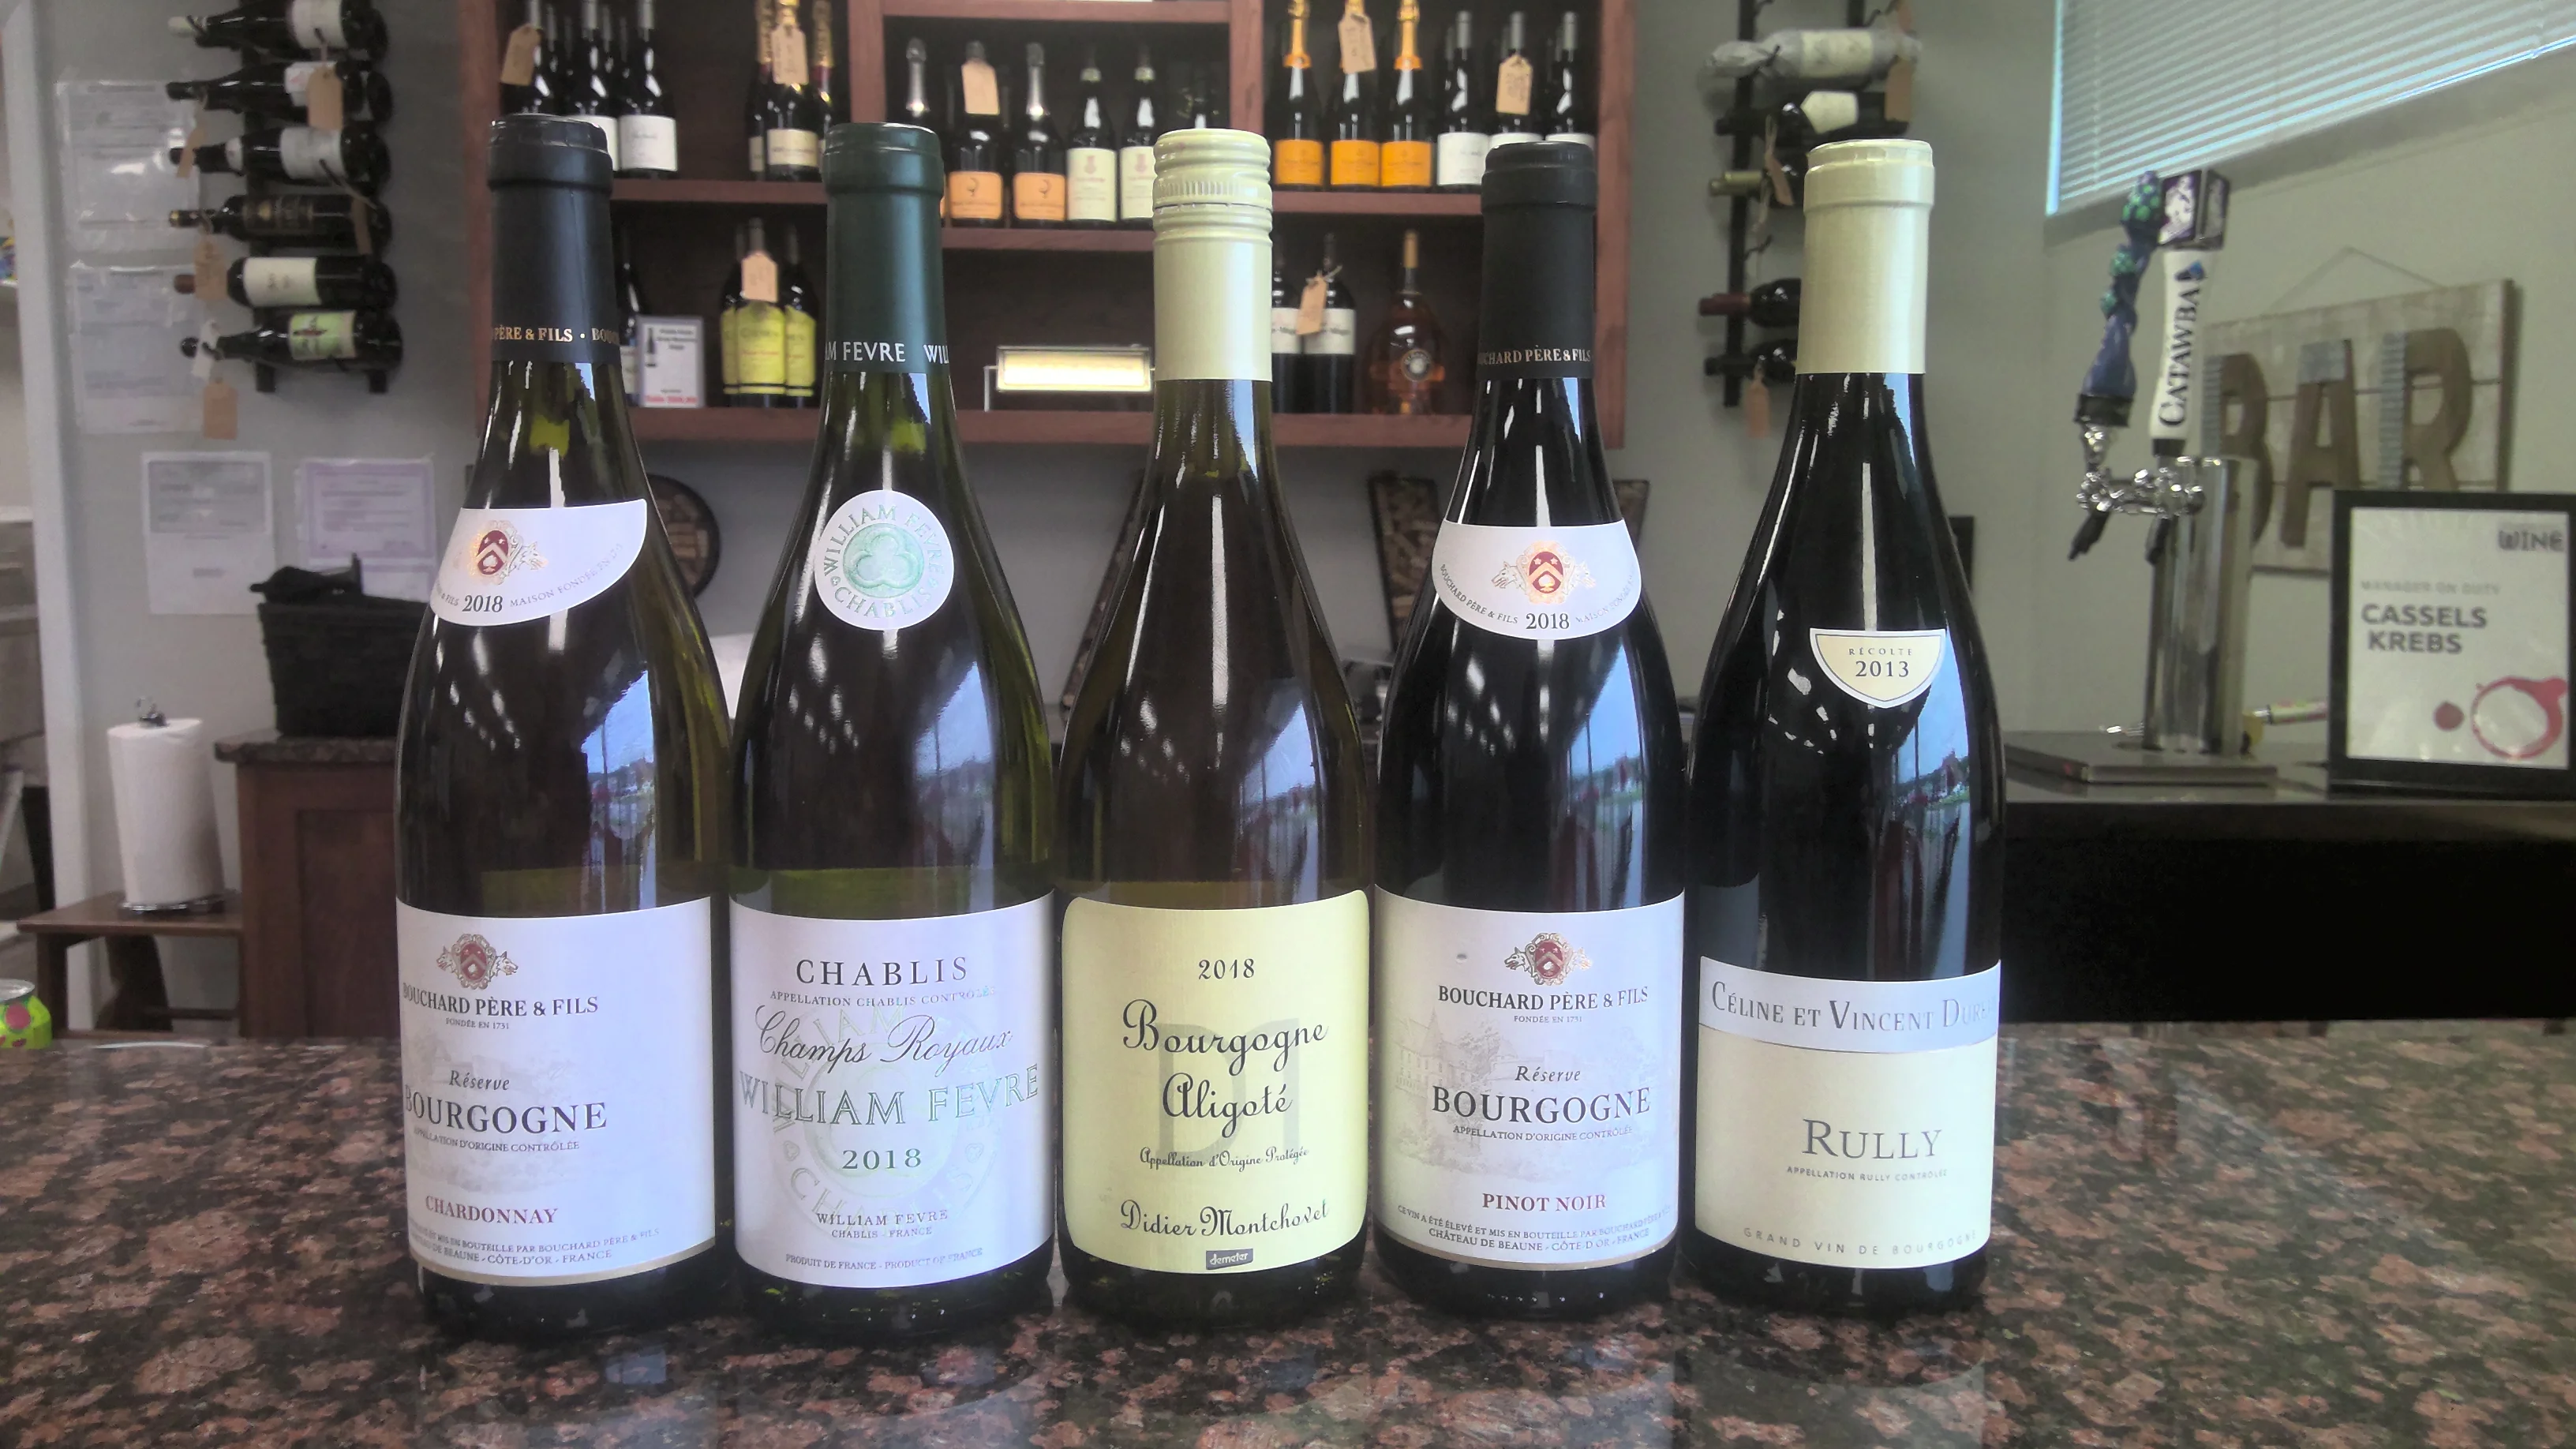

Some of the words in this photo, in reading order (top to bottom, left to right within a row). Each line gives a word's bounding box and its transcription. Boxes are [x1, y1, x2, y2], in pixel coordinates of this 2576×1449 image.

[526, 328, 534, 341] &
[538, 328, 573, 343] FILS
[843, 341, 906, 362] FEVRE
[1525, 344, 1562, 361] PÈRE
[1563, 350, 1571, 361] &
[1572, 349, 1591, 361] FILS
[2158, 286, 2202, 427] CATAWBA
[2202, 328, 2473, 548] BAR
[823, 504, 899, 576] WILLIAM
[904, 512, 945, 575] FEVRE
[2498, 530, 2563, 552] WINE
[445, 594, 460, 606] FILS
[462, 595, 504, 613] 2018
[510, 590, 556, 608] MAISON
[834, 586, 932, 619] CHABLIS
[1440, 564, 1466, 603] BOUCHARD
[1466, 600, 1486, 616] PÈRE
[1496, 612, 1518, 624] FILS
[1526, 613, 1570, 630] 2018
[1575, 605, 1609, 623] MAISON
[2361, 604, 2488, 628] CASSELS
[1849, 647, 1912, 656] RÉCOLTE
[2368, 631, 2462, 654] KREBS
[1855, 661, 1909, 677] 2013
[796, 957, 968, 986] CHABLIS
[1199, 958, 1255, 980] 2018
[402, 983, 470, 1014] BOUCHARD
[476, 996, 527, 1017] PÈRE
[533, 1002, 546, 1017] &
[552, 996, 598, 1015] FILS
[770, 990, 851, 1007] APPELLATION
[856, 996, 916, 1007] CHABLIS
[1439, 984, 1544, 1010] BOUCHARD
[1550, 989, 1598, 1010] PÈRE
[1603, 994, 1613, 1009] &
[1618, 986, 1649, 1008] FILS
[1514, 1014, 1549, 1024] FONDÉE
[754, 1005, 872, 1073] Champs
[880, 1014, 1013, 1077] Royaux
[1122, 998, 1329, 1076] Bourgogne
[448, 1069, 510, 1091] Réserve
[1515, 1065, 1581, 1082] Réserve
[739, 1070, 906, 1125] WILLIAM
[928, 1063, 1039, 1122] FEVRE
[1163, 1072, 1293, 1138] Aligoté
[1432, 1085, 1650, 1124] BOURGOGNE
[405, 1084, 607, 1134] BOURGOGNE
[1453, 1125, 1522, 1141] APPELLATION
[1526, 1132, 1577, 1142] D'ORIGINE
[459, 1139, 508, 1152] D'ORIGINE
[511, 1140, 580, 1152] CONTRÔLÉE
[842, 1148, 922, 1170] 2018
[1140, 1146, 1206, 1170] Appellation
[1209, 1150, 1263, 1173] d'Origine
[1265, 1146, 1310, 1166] Protégée
[1787, 1166, 1855, 1180] APPELLATION
[425, 1195, 559, 1224] CHARDONNAY
[1482, 1193, 1549, 1212] PINOT
[1556, 1194, 1607, 1212] NOIR
[816, 1212, 887, 1226] WILLIAM
[895, 1209, 949, 1225] FEVRE
[1120, 1199, 1197, 1236] Didier
[1199, 1199, 1329, 1237] Montchovet
[1407, 1209, 1420, 1221] VIN
[1421, 1214, 1427, 1223] A
[1428, 1215, 1443, 1227] ÉTÉ
[1444, 1219, 1473, 1234] ÉLEVÉ
[1475, 1226, 1487, 1236] ET
[1489, 1228, 1506, 1237] MIS
[1508, 1230, 1521, 1238] EN
[1523, 1231, 1578, 1240] BOUTEILLE
[1580, 1228, 1598, 1239] PAR
[462, 1240, 514, 1253] BOUTEILLE
[516, 1245, 535, 1253] PAR
[538, 1240, 601, 1253] BOUCHARD
[603, 1234, 629, 1246] PÈRE
[640, 1227, 660, 1239] FILS
[831, 1229, 878, 1238] CHABLIS
[889, 1226, 933, 1237] FRANCE
[1428, 1227, 1479, 1247] CHÂTEAU
[1481, 1237, 1496, 1248] DE
[1499, 1239, 1543, 1251] BEAUNE
[1617, 1228, 1650, 1245] FRANCE
[1743, 1227, 1801, 1248] GRAND
[1814, 1241, 1844, 1253] VIN
[1859, 1245, 1879, 1255] DE
[1893, 1230, 1977, 1255] BOURGOGNE
[444, 1247, 480, 1262] BEAUNE
[562, 1249, 612, 1264] FRANCE
[785, 1252, 822, 1267] PRODUIT
[824, 1260, 837, 1269] DE
[838, 1261, 876, 1270] FRANCE
[885, 1258, 930, 1269] PRODUCT
[1210, 1252, 1249, 1266] demeter
